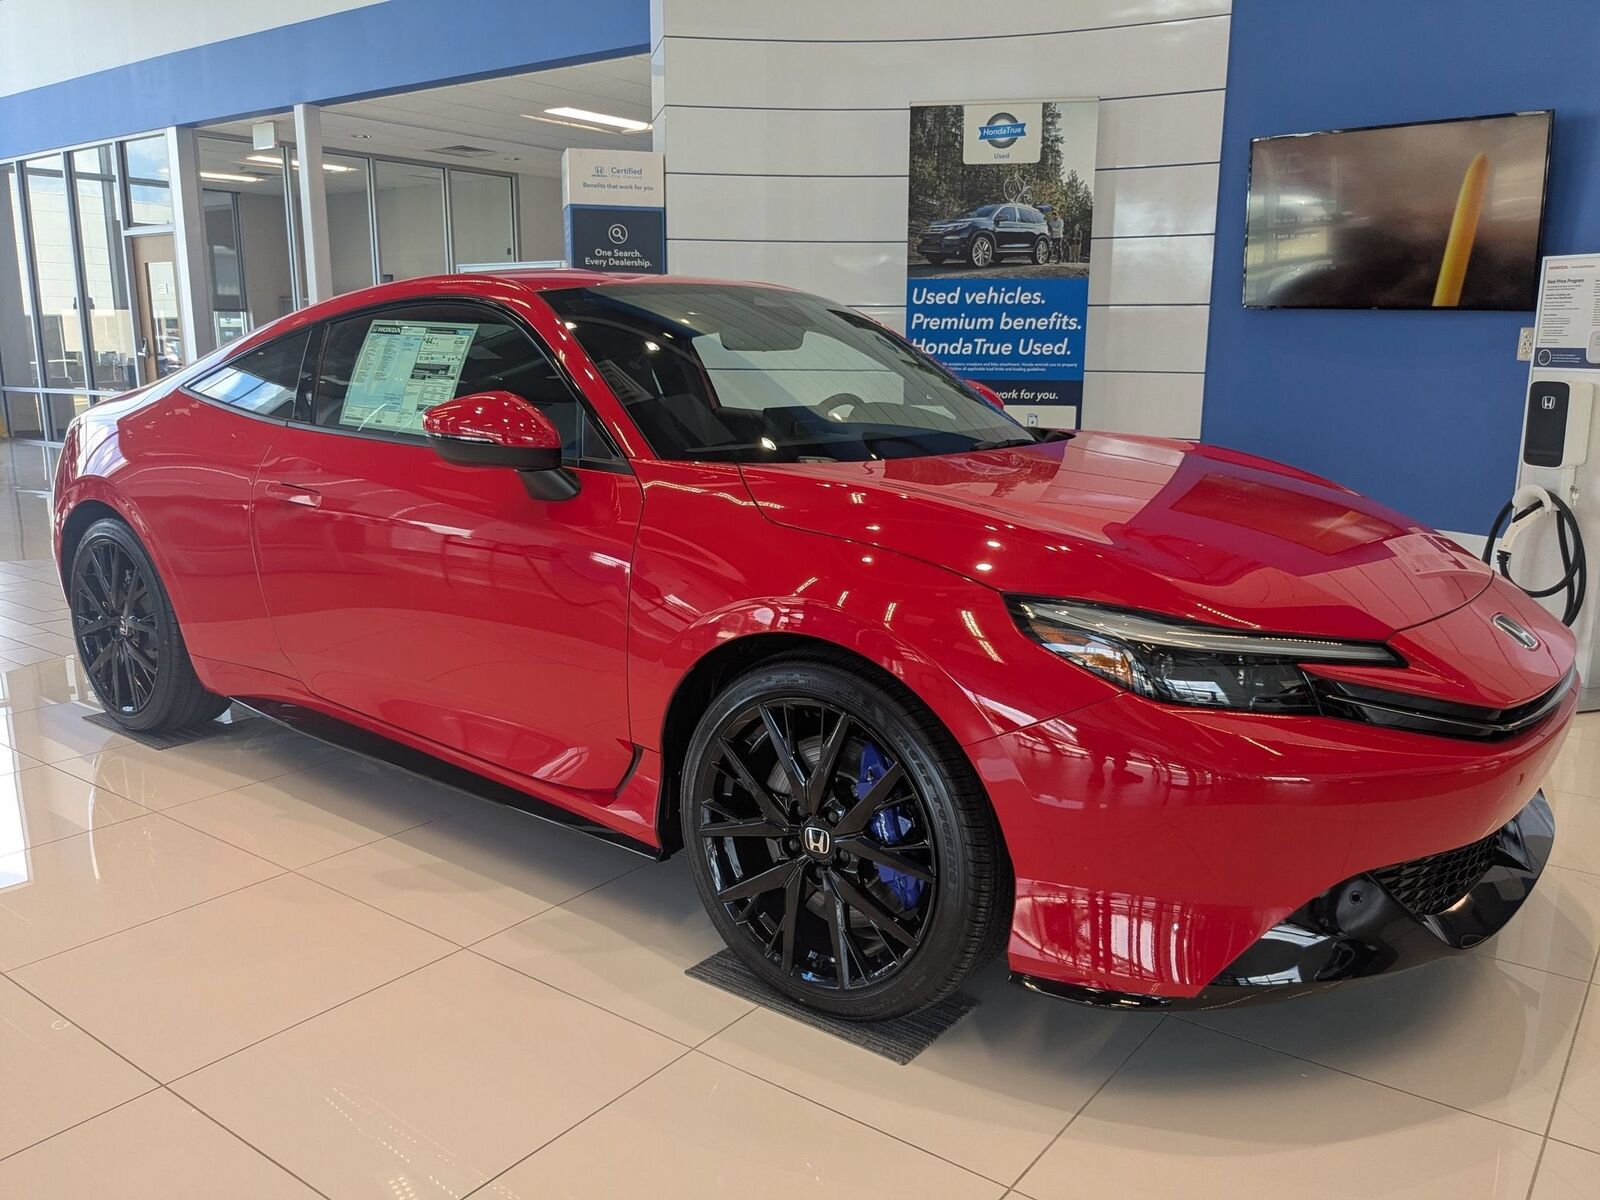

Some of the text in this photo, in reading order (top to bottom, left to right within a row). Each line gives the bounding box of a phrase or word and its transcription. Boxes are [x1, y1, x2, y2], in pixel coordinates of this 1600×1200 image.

[982, 126, 1022, 136] HondaTrue
[610, 167, 643, 176] Certified
[594, 248, 642, 258] One Search.
[584, 258, 652, 268] Every Dealership.
[912, 286, 1046, 304] Used vehicles.
[912, 312, 1082, 330] Premium benefits.
[912, 338, 1071, 356] HondaTrue Used.
[1020, 389, 1036, 399] for
[1036, 392, 1058, 402] you.
